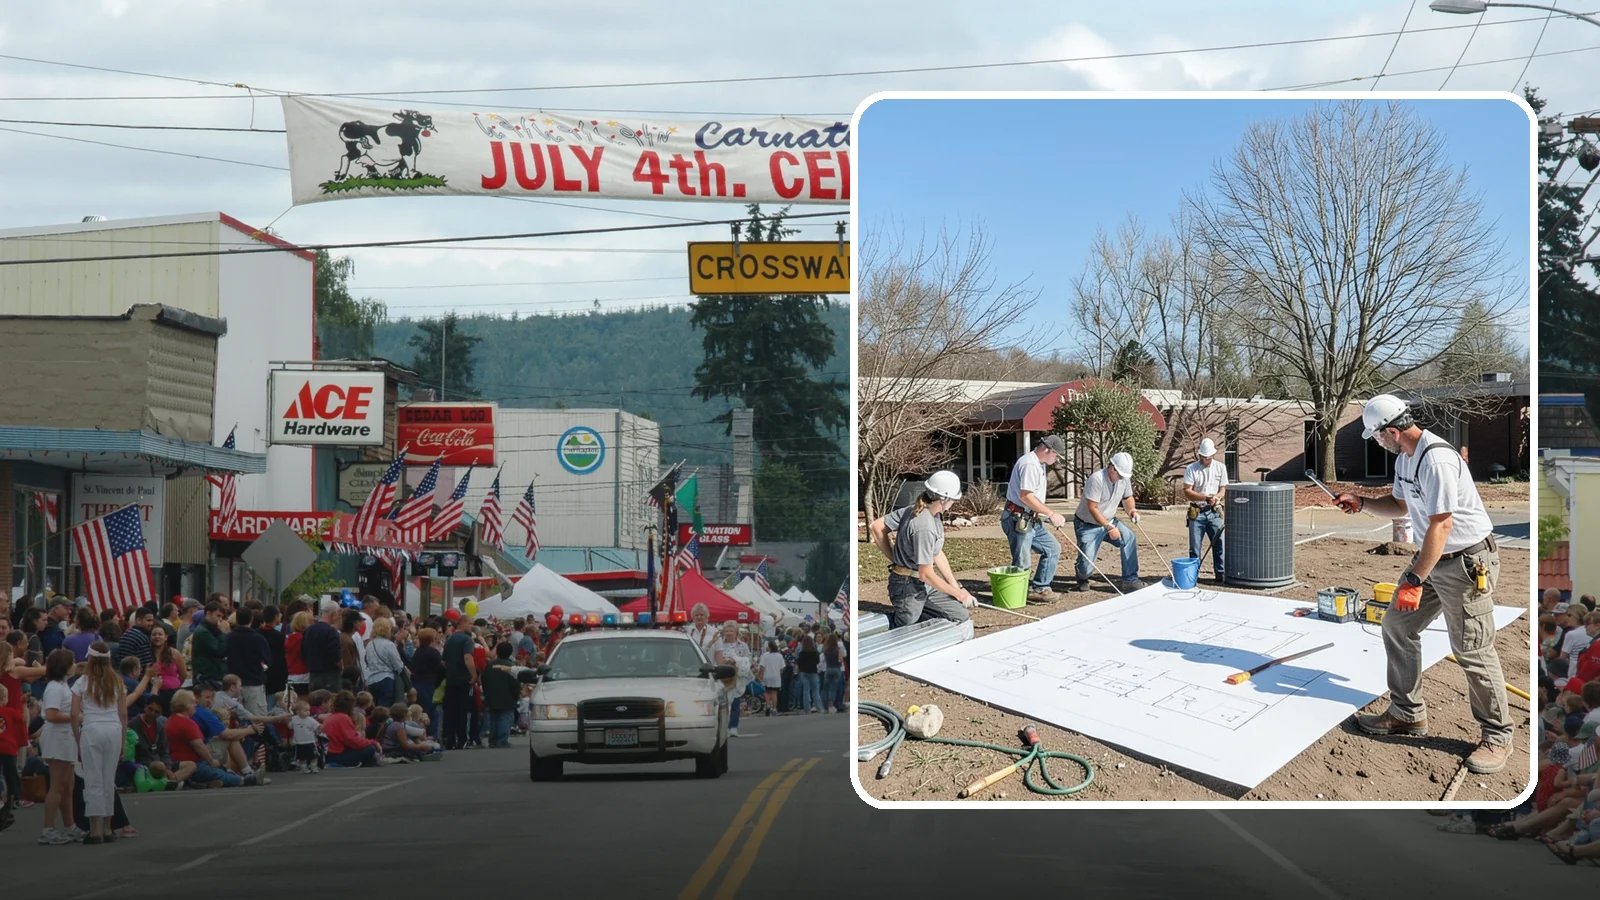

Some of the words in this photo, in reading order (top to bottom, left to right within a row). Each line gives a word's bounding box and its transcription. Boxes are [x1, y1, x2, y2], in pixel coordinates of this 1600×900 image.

[481, 141, 605, 192] JULY
[632, 150, 746, 198] 4th.
[697, 254, 850, 280] CROSSWA
[282, 380, 373, 419] ACE
[406, 409, 452, 422] CEDAR
[283, 421, 371, 436] Hardware
[416, 428, 477, 447] Coca-Cola
[96, 485, 123, 494] Vincent
[126, 486, 135, 494] de
[137, 486, 155, 495] Paul
[688, 526, 741, 535] CRNATION
[699, 535, 730, 543] GLASS
